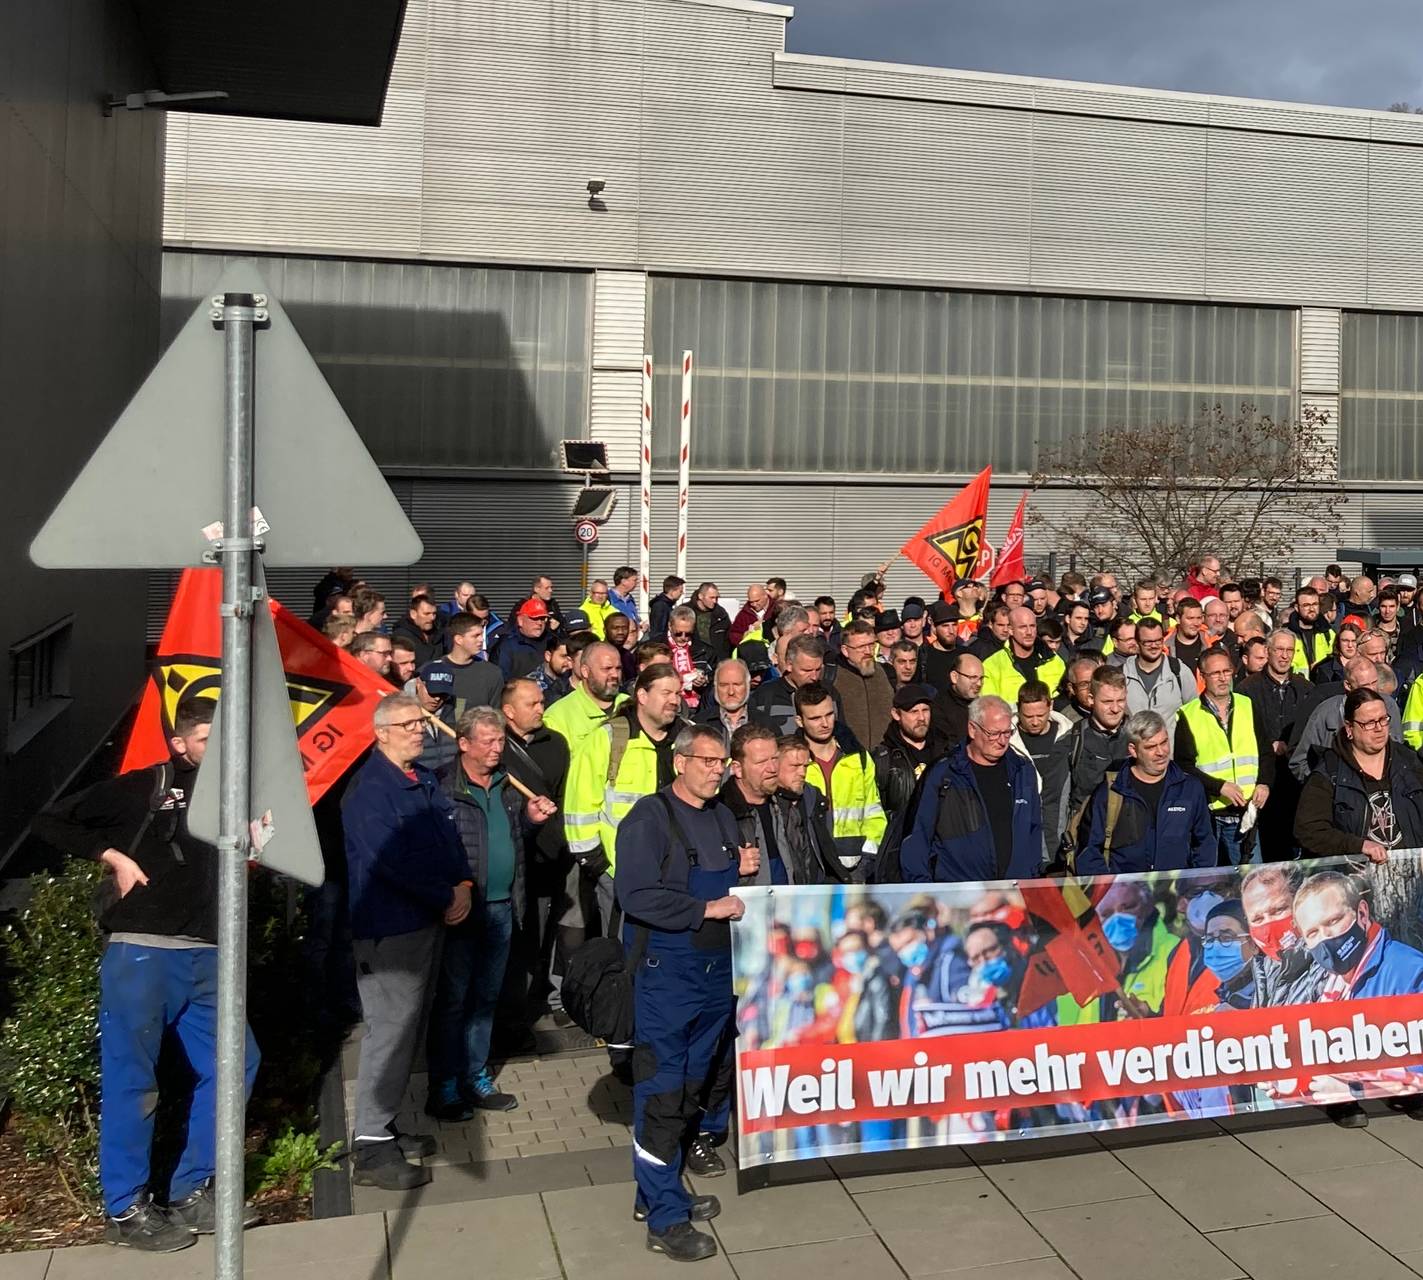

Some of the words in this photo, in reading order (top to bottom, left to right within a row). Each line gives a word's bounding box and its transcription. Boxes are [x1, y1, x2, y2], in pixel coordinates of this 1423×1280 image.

[580, 527, 593, 538] 20
[740, 1058, 857, 1121] Weil
[867, 1051, 952, 1107] wir
[963, 1043, 1086, 1101] mehr
[1096, 1025, 1292, 1087] verdient
